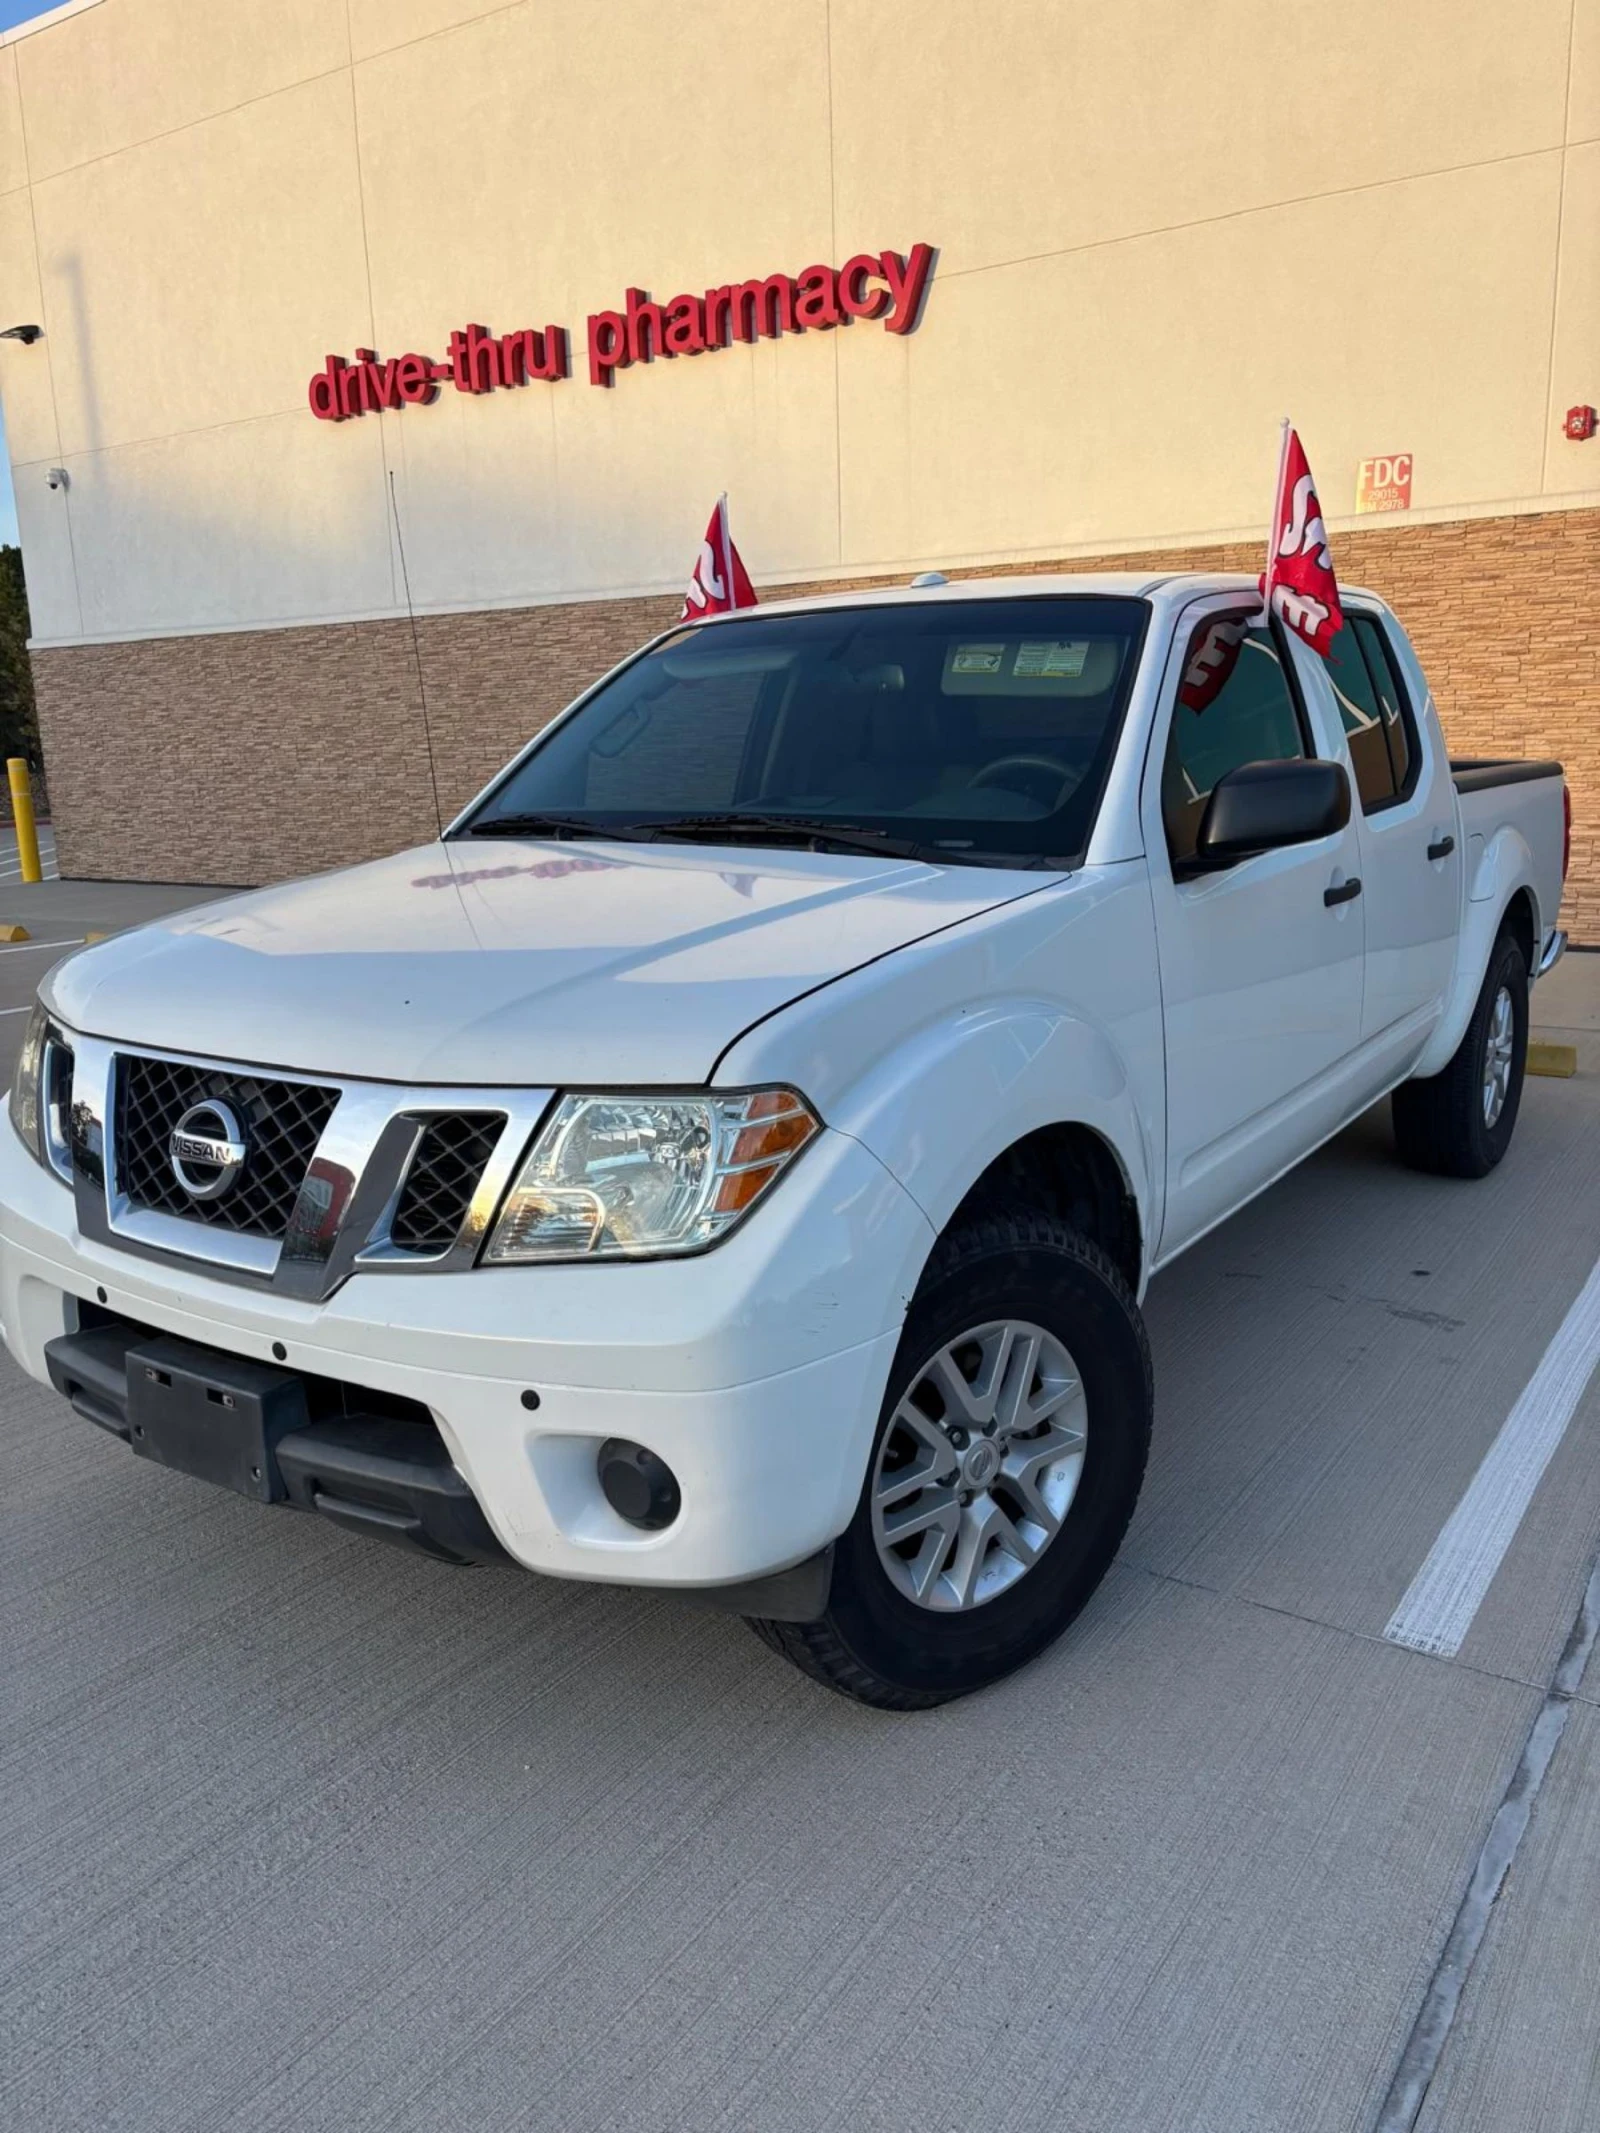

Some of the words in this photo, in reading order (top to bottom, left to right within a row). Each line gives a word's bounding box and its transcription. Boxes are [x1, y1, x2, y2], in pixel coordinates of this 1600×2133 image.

[309, 323, 568, 421] drive-thru
[587, 243, 933, 388] pharmacy
[1358, 456, 1410, 489] FDC
[1367, 488, 1399, 501] 29015
[1379, 499, 1404, 511] 2978
[171, 1134, 230, 1161] NISSAN
